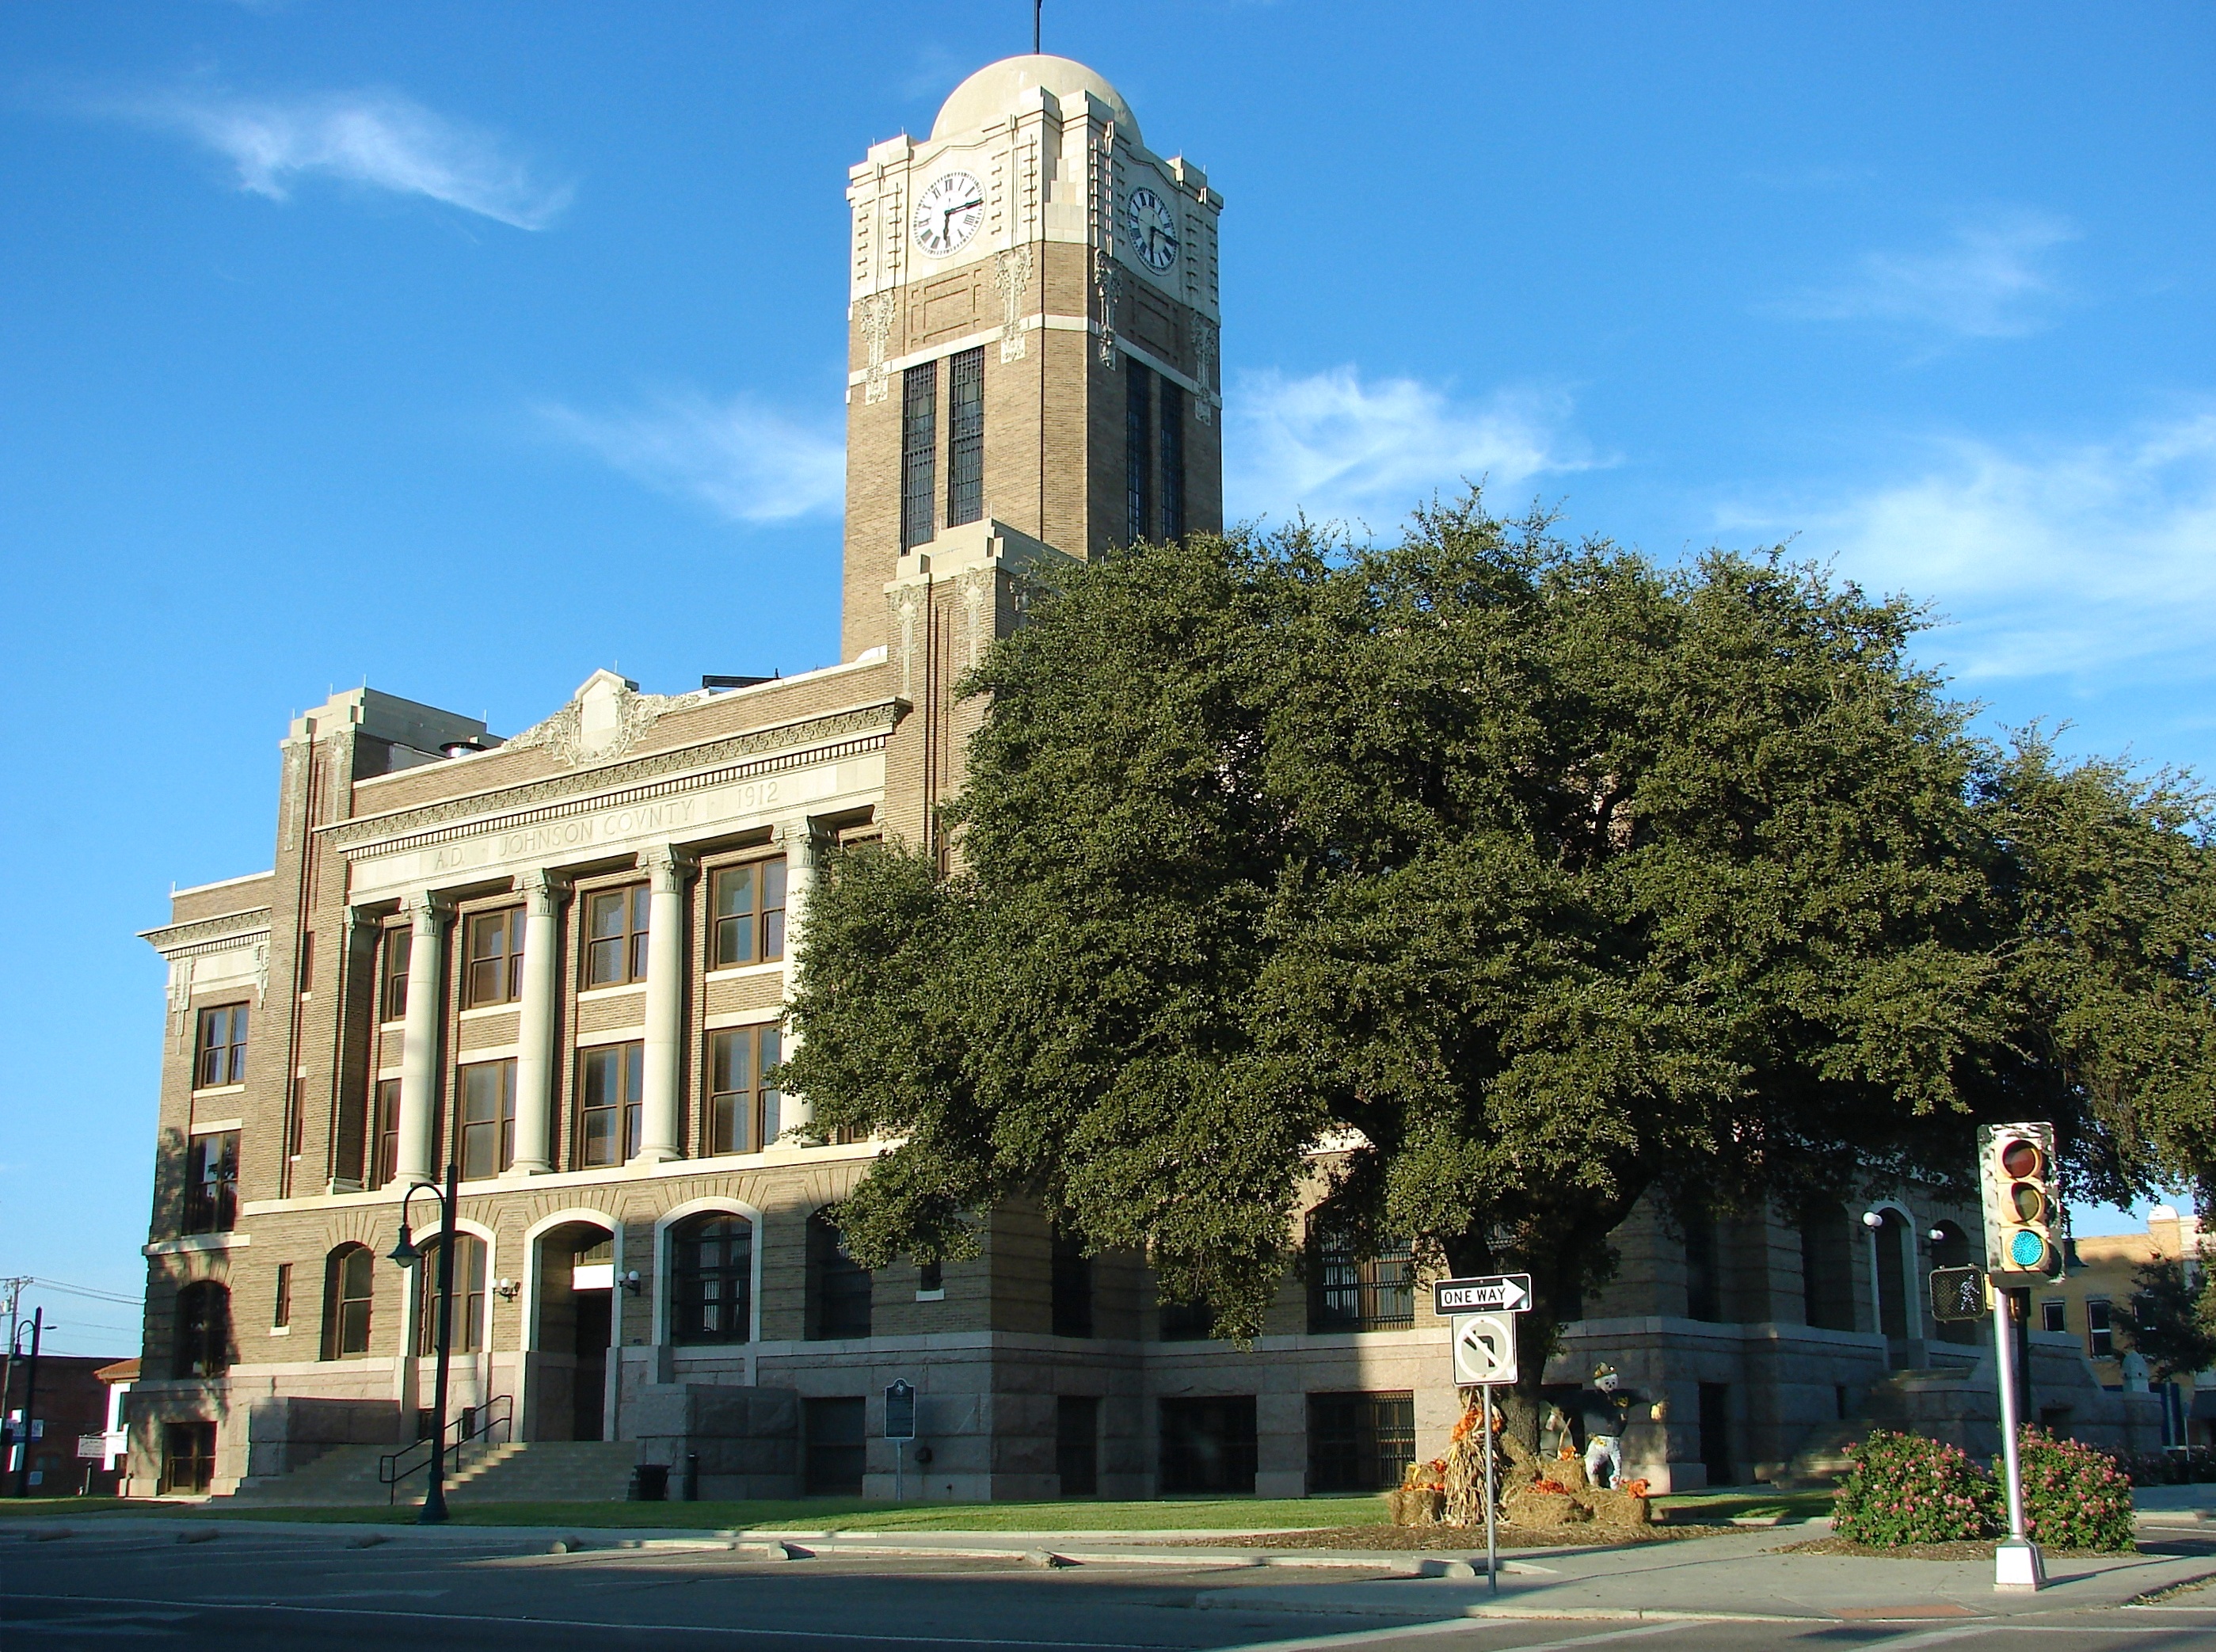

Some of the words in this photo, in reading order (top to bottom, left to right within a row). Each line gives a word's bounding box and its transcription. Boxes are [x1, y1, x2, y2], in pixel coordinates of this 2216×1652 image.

[500, 820, 594, 857] JOHNSON
[737, 781, 779, 809] 1912
[1445, 1290, 1472, 1304] ONE
[1477, 1288, 1506, 1302] WAY
